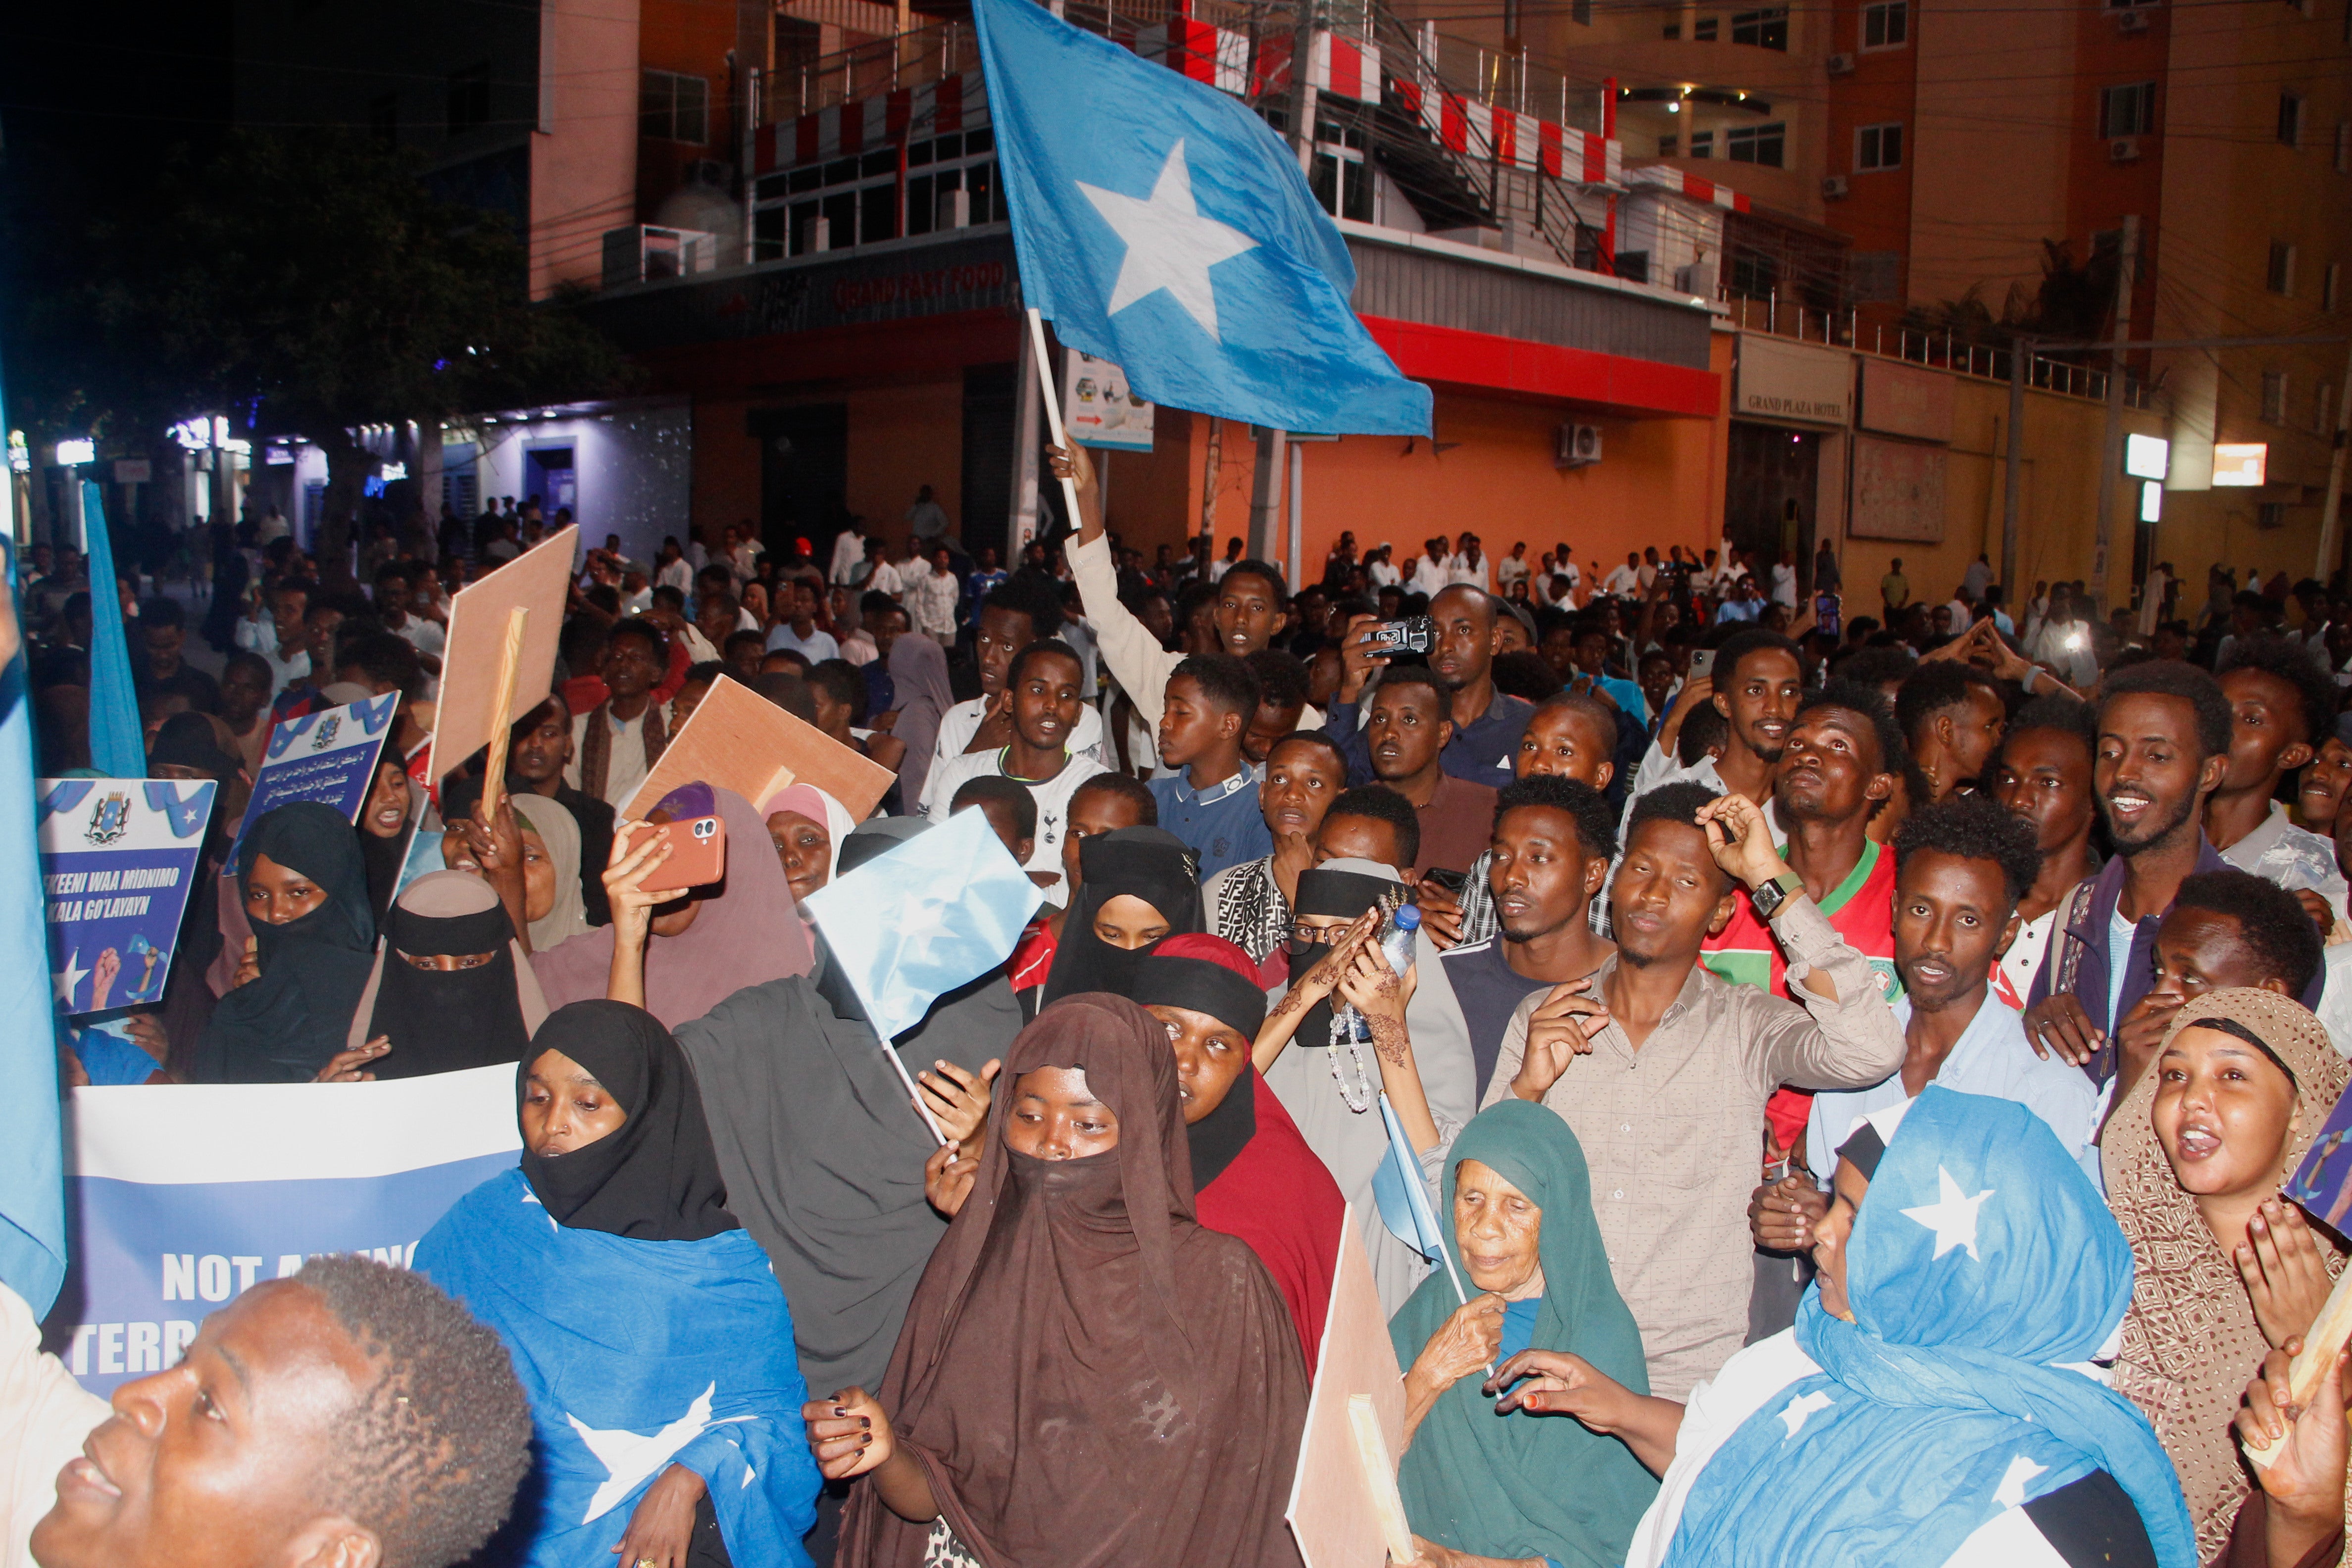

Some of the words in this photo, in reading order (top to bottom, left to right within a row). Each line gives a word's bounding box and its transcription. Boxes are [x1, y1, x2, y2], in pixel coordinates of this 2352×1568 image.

[899, 269, 946, 301] FAST
[951, 261, 1004, 294] FOOD
[1748, 394, 1781, 410] GRAND
[1783, 398, 1812, 414] PLAZA
[1813, 401, 1842, 417] HOTEL
[88, 870, 121, 892] WAA
[120, 867, 181, 890] MIDNIMO
[46, 900, 83, 923] KALA
[83, 895, 151, 921] GO'LAYAYN
[162, 1253, 263, 1302] NOT
